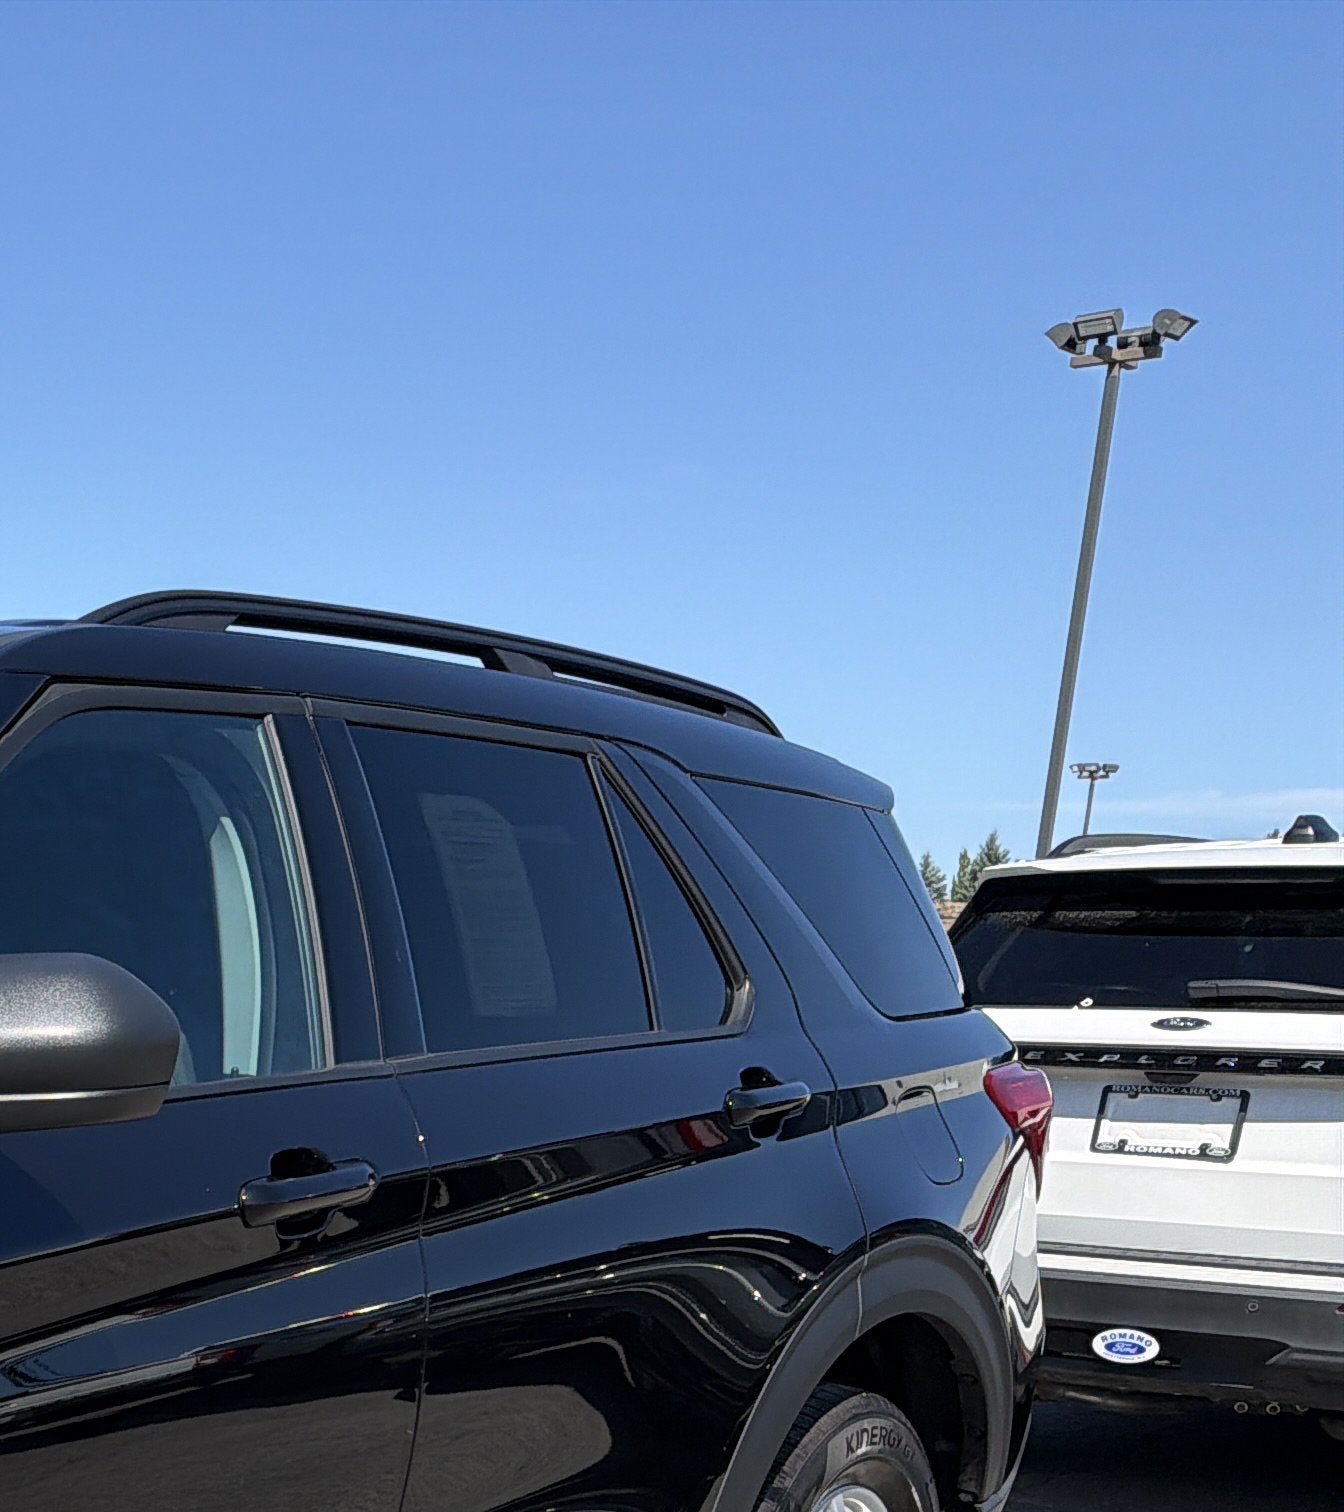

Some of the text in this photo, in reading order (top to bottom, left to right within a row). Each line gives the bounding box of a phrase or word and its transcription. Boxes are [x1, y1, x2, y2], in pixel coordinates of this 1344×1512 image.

[1023, 1050, 1326, 1072] EXPLORER
[1112, 1085, 1242, 1097] ROMANOCARS.COM
[1124, 1144, 1201, 1156] ROMANO
[1100, 1332, 1153, 1348] ROMANO
[844, 1425, 904, 1457] KINERGY
